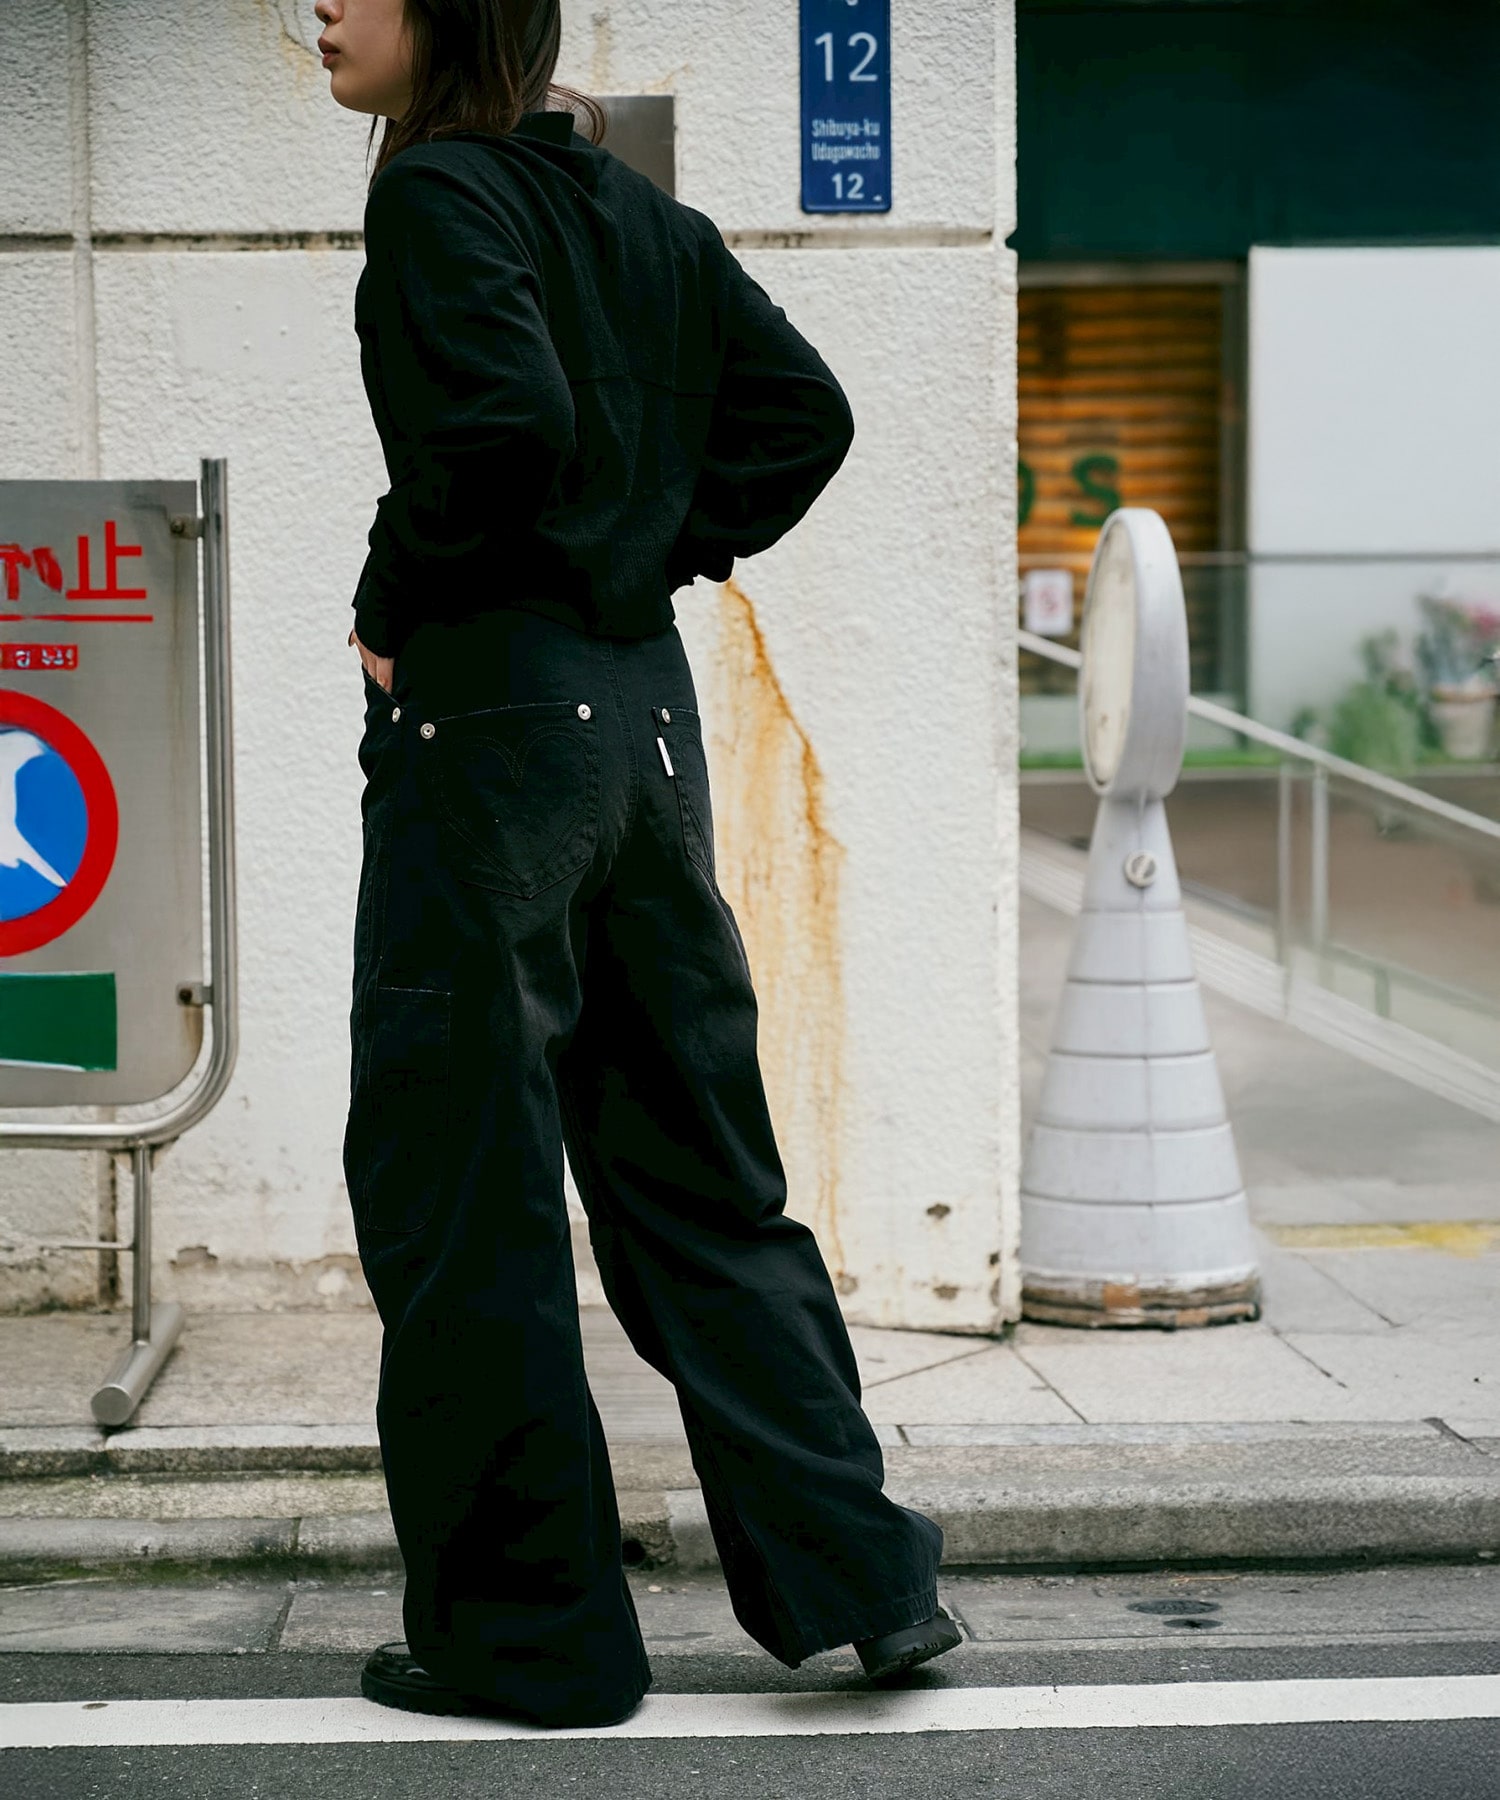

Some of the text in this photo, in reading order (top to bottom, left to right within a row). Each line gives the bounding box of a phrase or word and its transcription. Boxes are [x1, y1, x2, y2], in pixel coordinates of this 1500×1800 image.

[814, 32, 878, 82] 12
[811, 118, 880, 140] Shibuya-ku
[811, 142, 881, 164] Udagawacho
